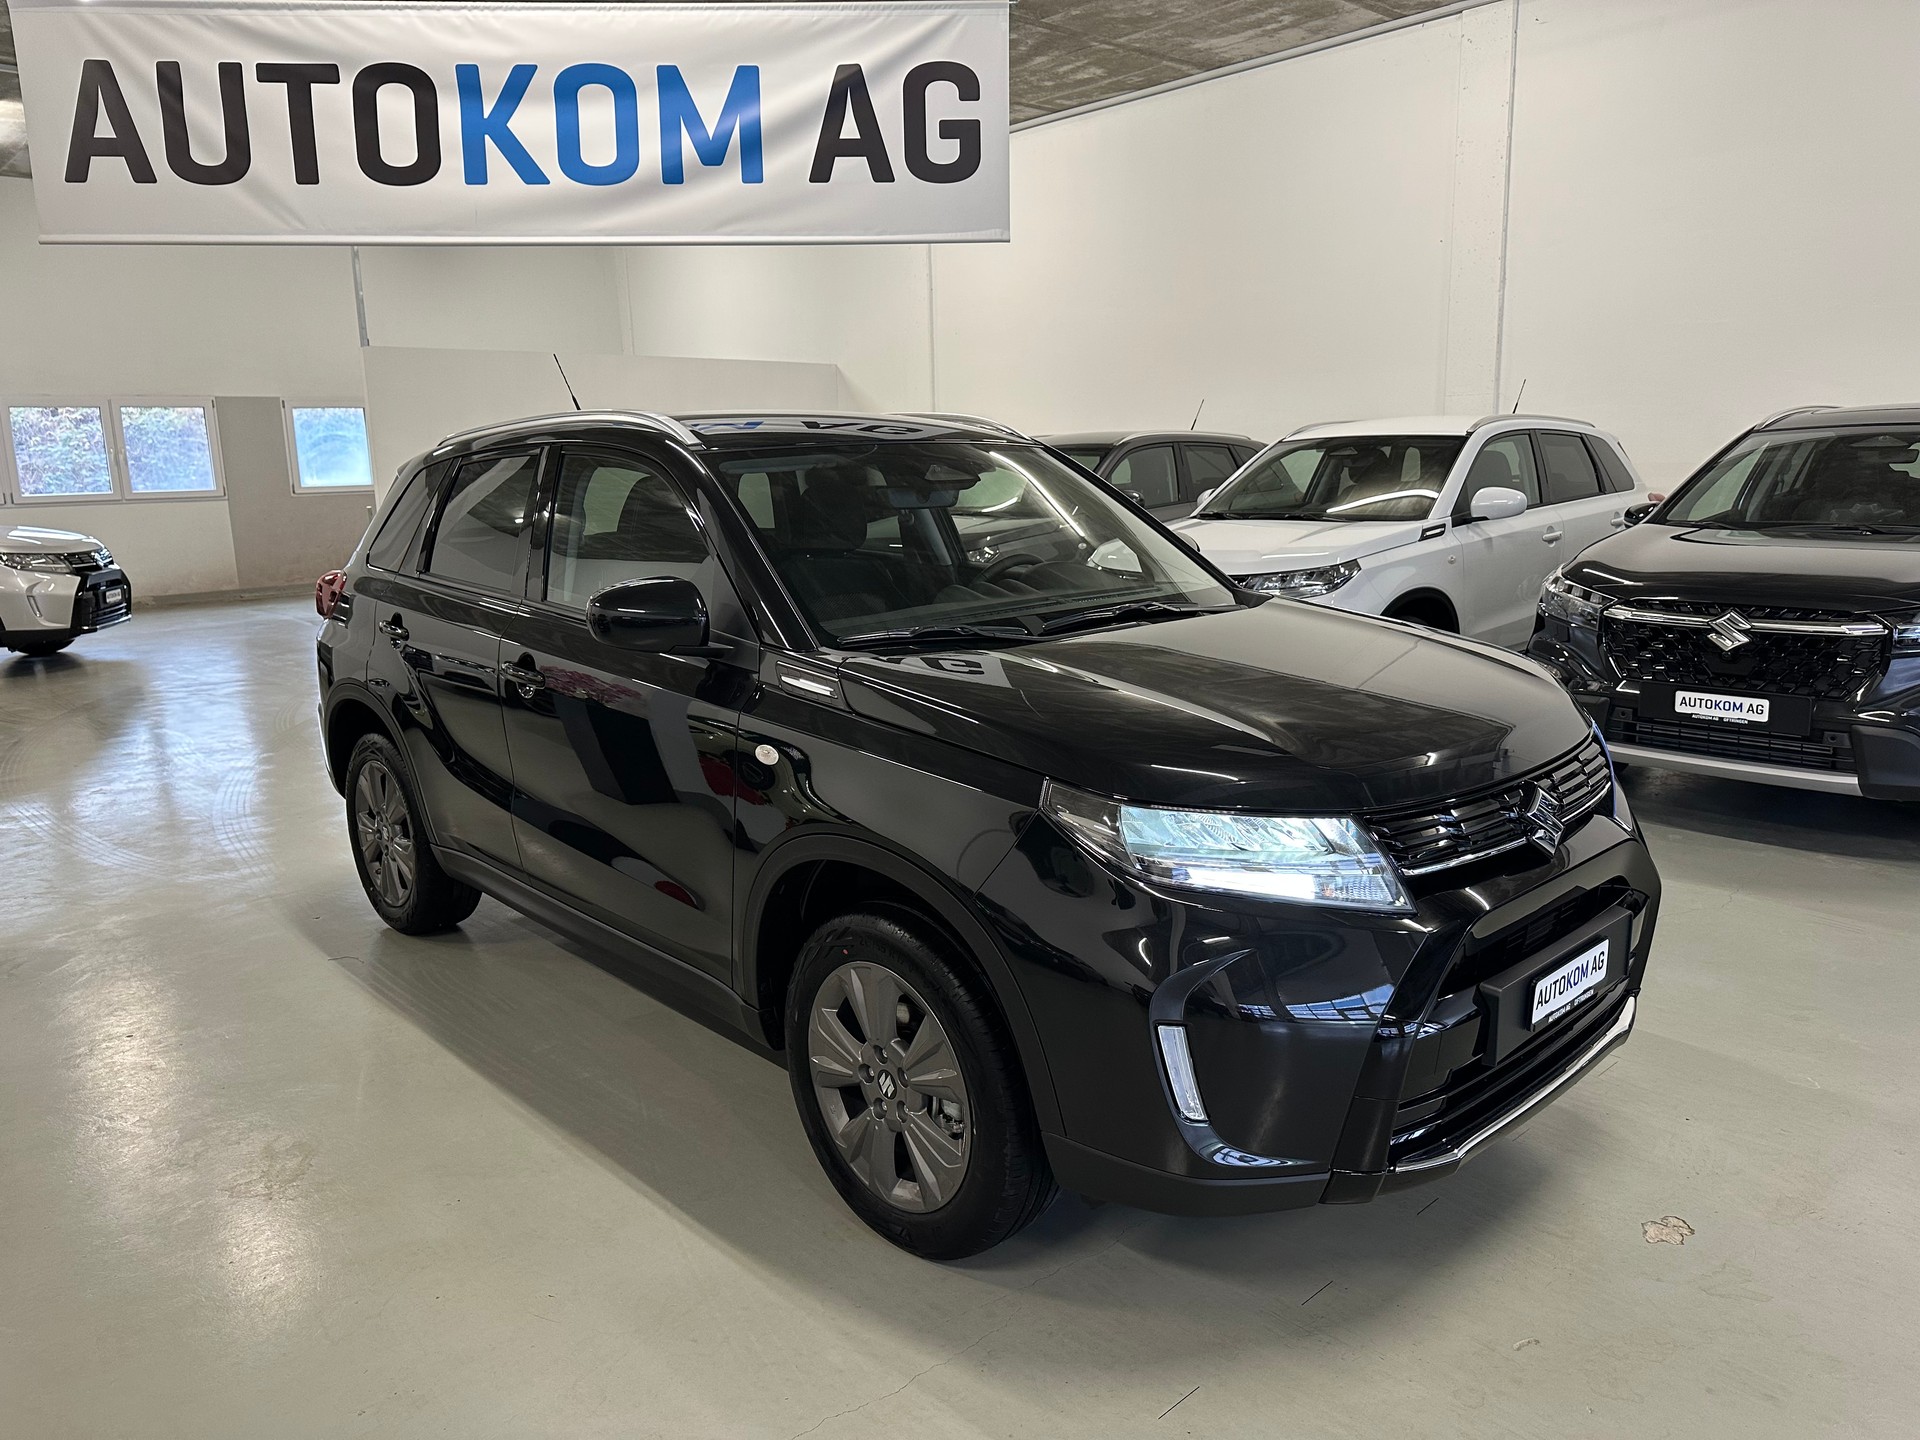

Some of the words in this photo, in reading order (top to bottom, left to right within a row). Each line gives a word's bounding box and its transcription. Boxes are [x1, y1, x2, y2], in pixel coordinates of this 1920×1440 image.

[64, 59, 764, 186] AUTOKOM
[808, 61, 982, 185] AG
[1679, 696, 1743, 713] AUTOKOM
[1746, 703, 1764, 715] AG
[1535, 959, 1590, 1011] AUTOKOM
[1590, 951, 1605, 976] AG
